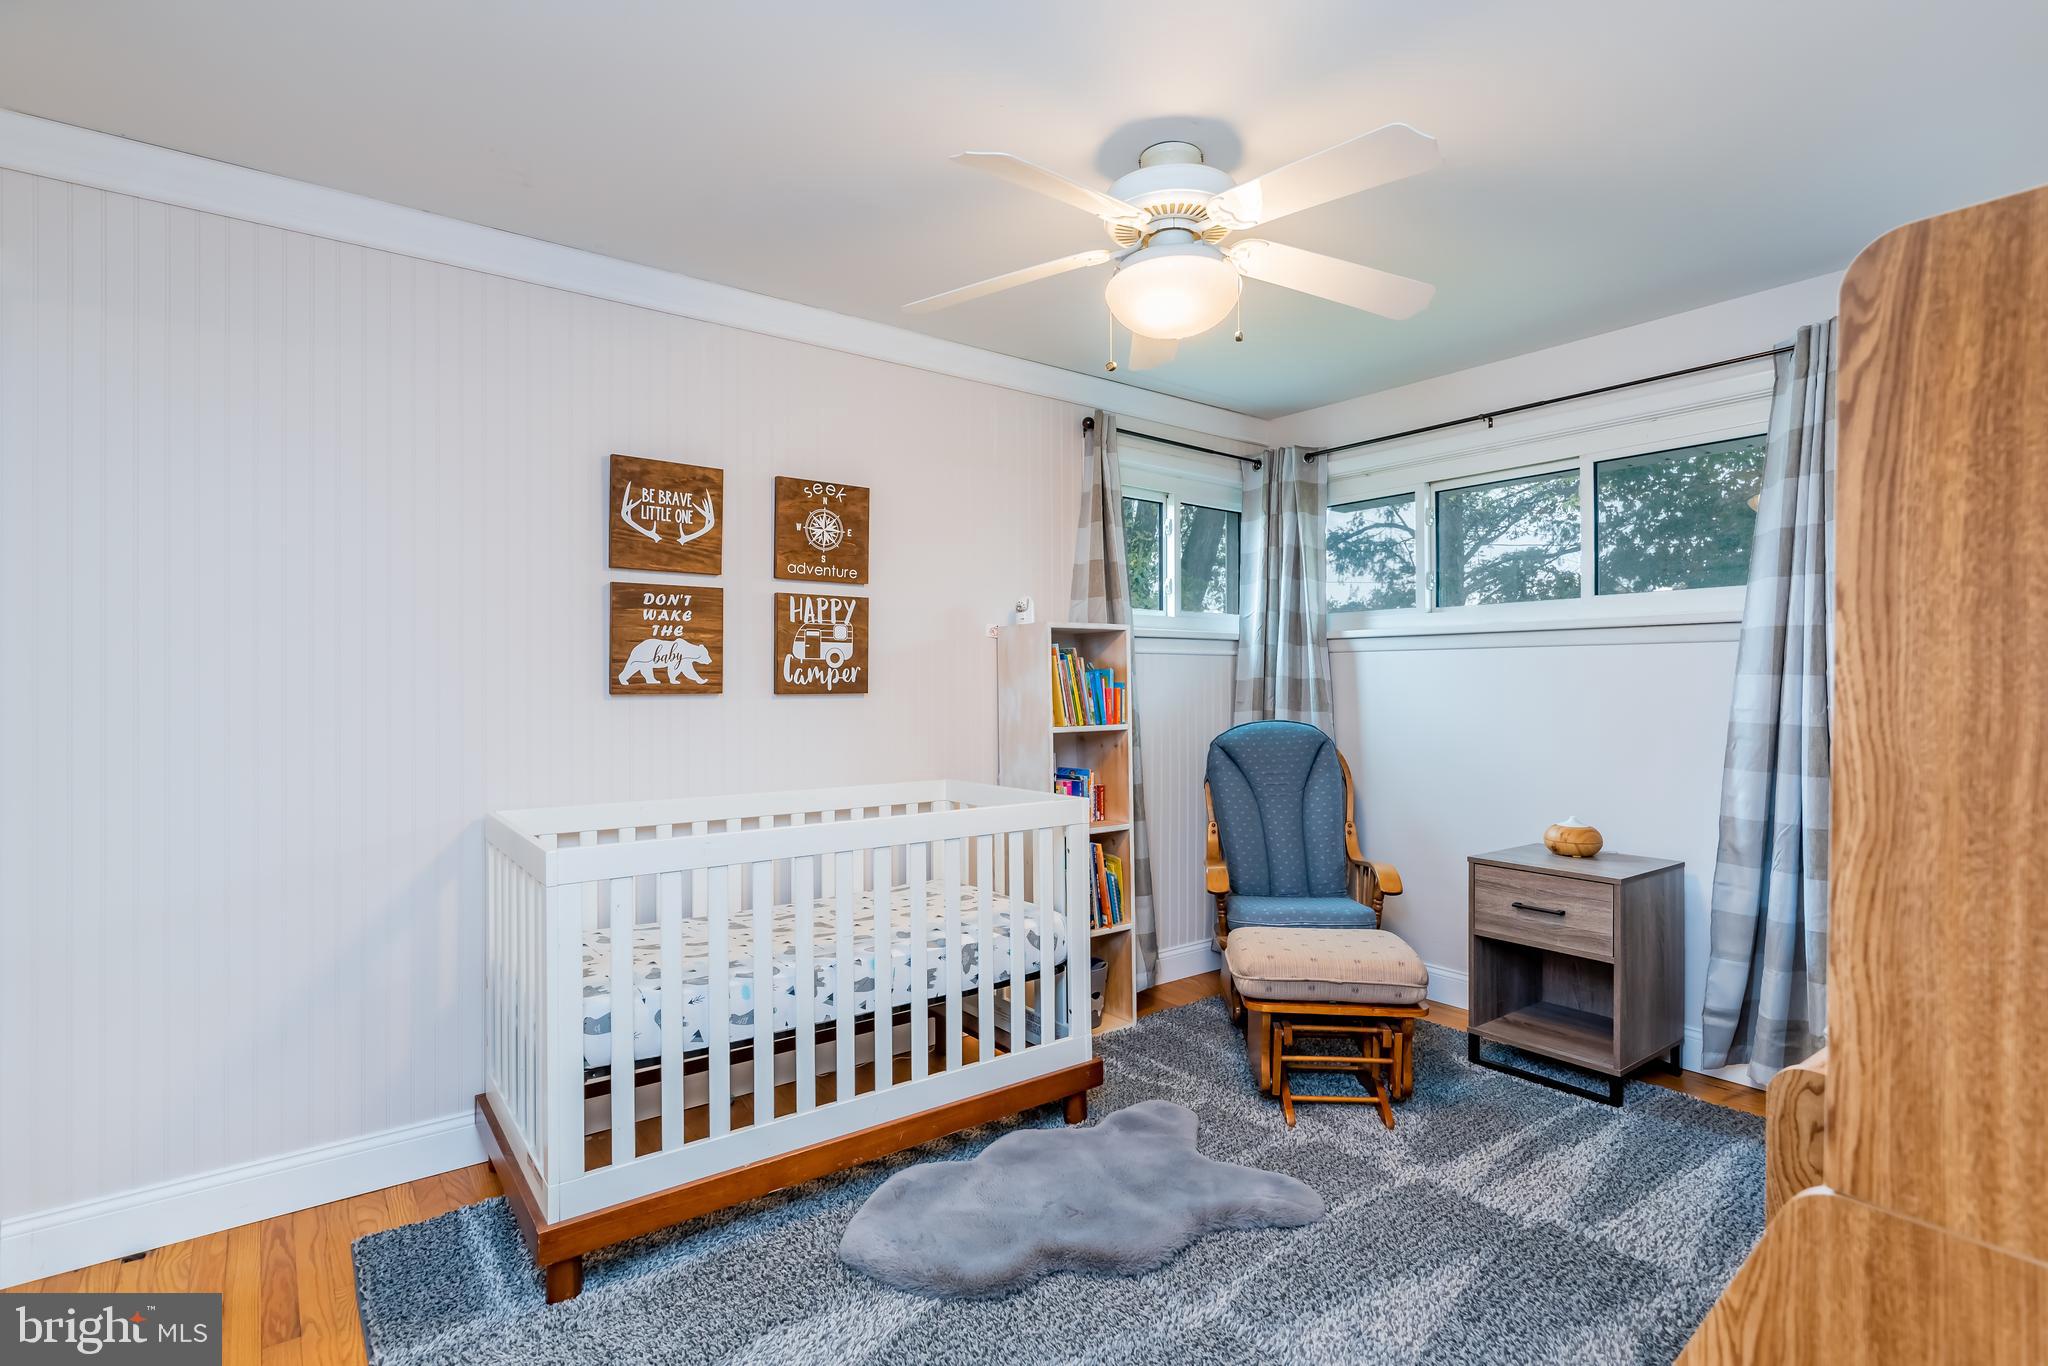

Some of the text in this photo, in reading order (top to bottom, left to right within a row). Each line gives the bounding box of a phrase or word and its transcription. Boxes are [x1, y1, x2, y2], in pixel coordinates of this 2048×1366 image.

[642, 487, 693, 508] BE BRAVE
[803, 483, 847, 503] seek
[822, 496, 828, 505] N
[641, 505, 693, 525] LITTLE ONE
[796, 523, 802, 531] W
[847, 529, 852, 537] E
[821, 555, 826, 563] S
[787, 562, 858, 579] adventure
[643, 592, 692, 606] DON'T
[643, 608, 692, 621] WAKE
[789, 595, 857, 624] HAPPY
[652, 625, 684, 637] THE
[653, 642, 683, 670] baby
[783, 653, 861, 691] Camper
